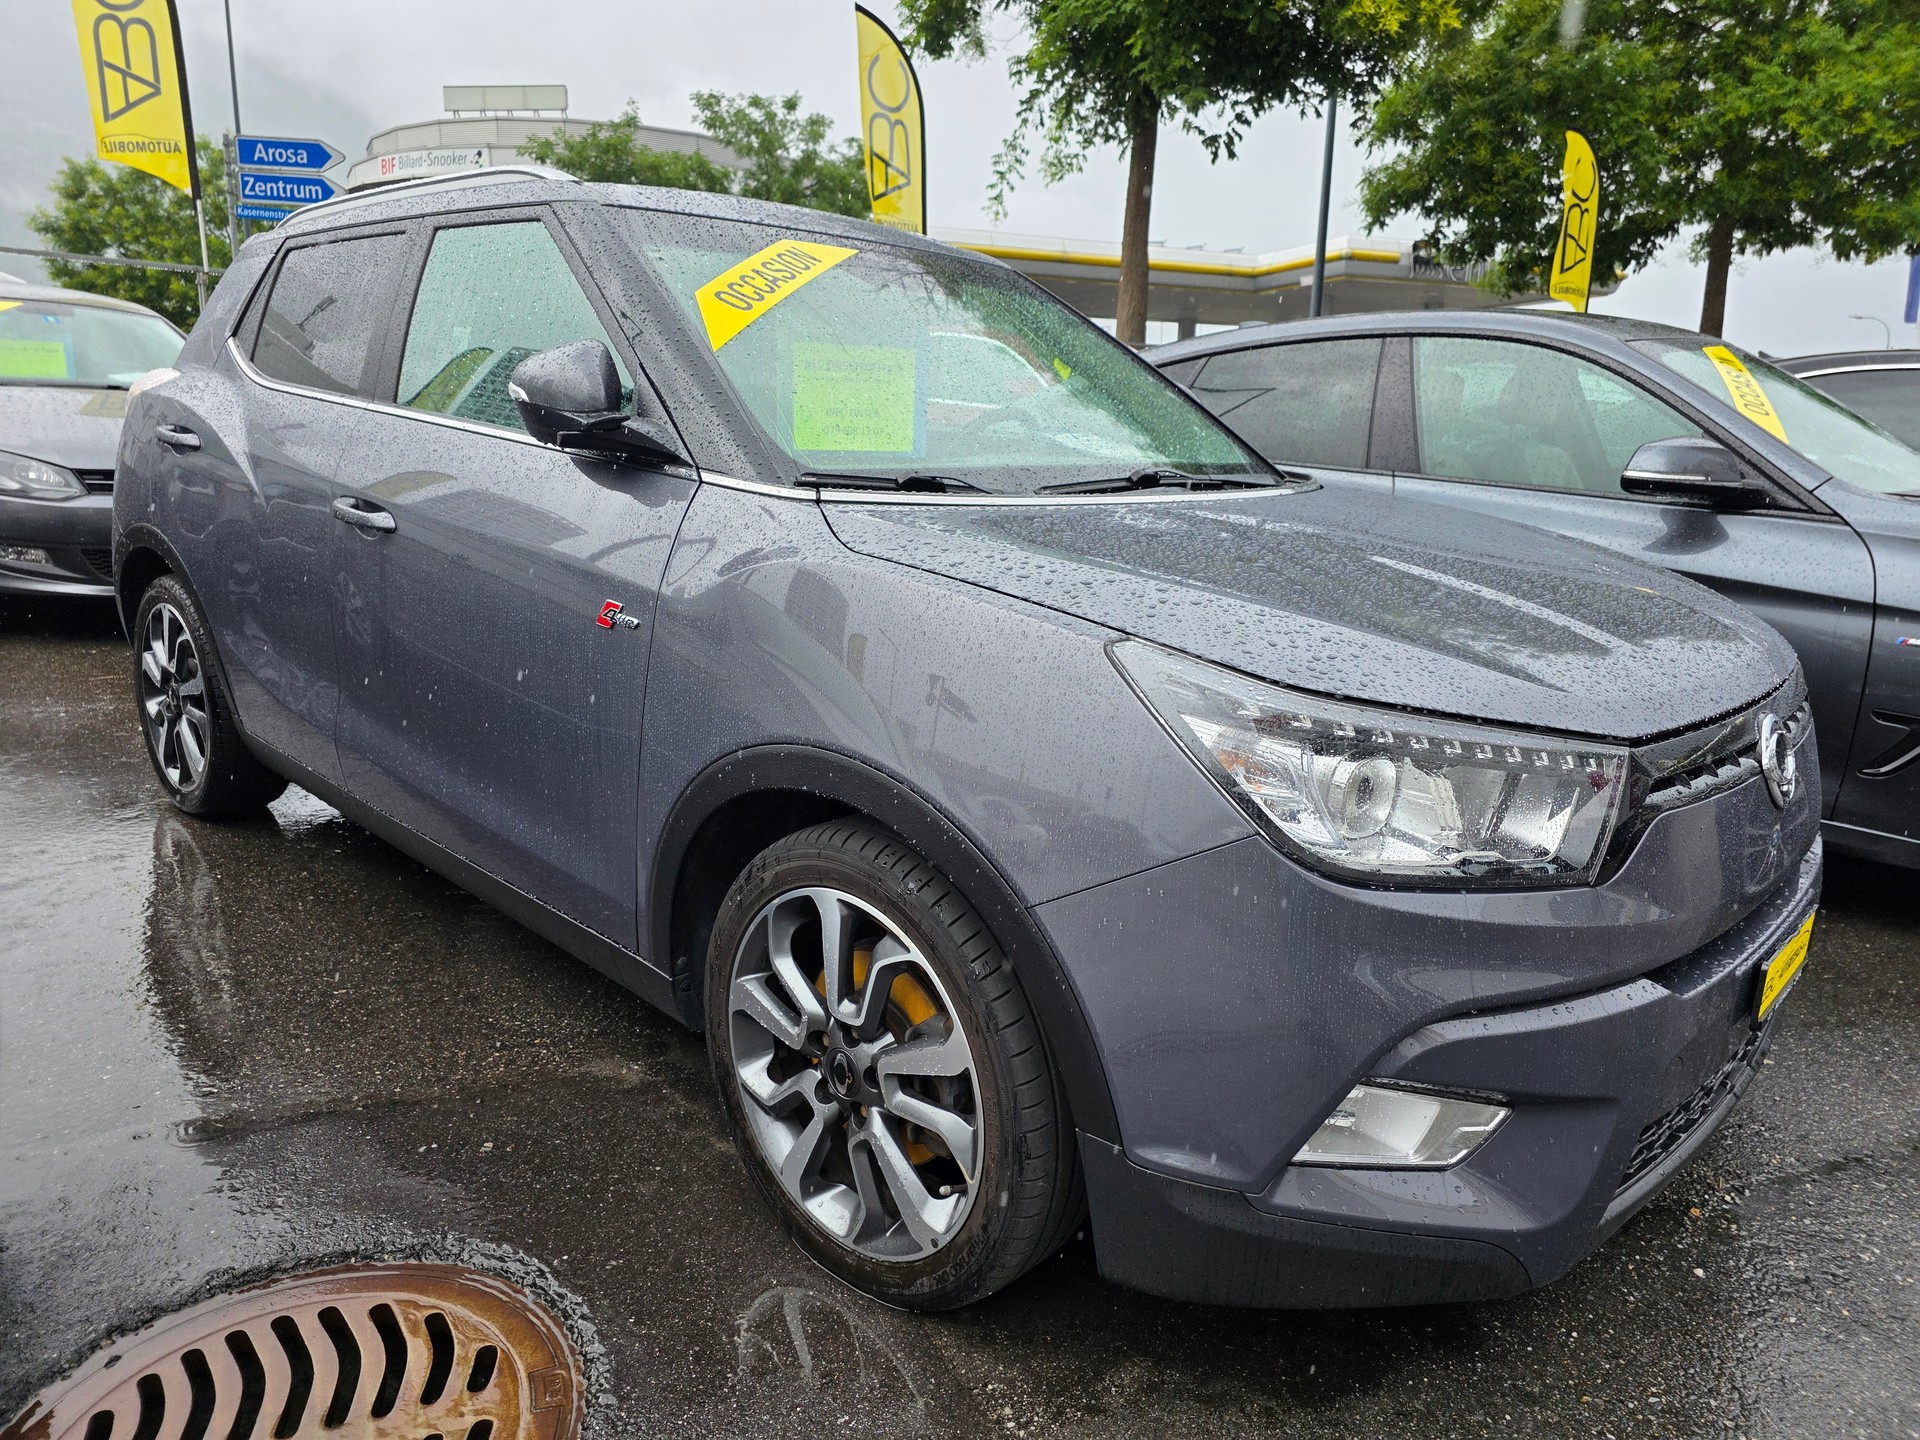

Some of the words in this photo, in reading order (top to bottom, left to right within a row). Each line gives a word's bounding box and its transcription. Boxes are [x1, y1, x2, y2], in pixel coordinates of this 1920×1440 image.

[253, 142, 308, 164] Arosa
[381, 157, 396, 176] BIF
[243, 177, 323, 200] Zentrum
[714, 246, 822, 311] OCCASION
